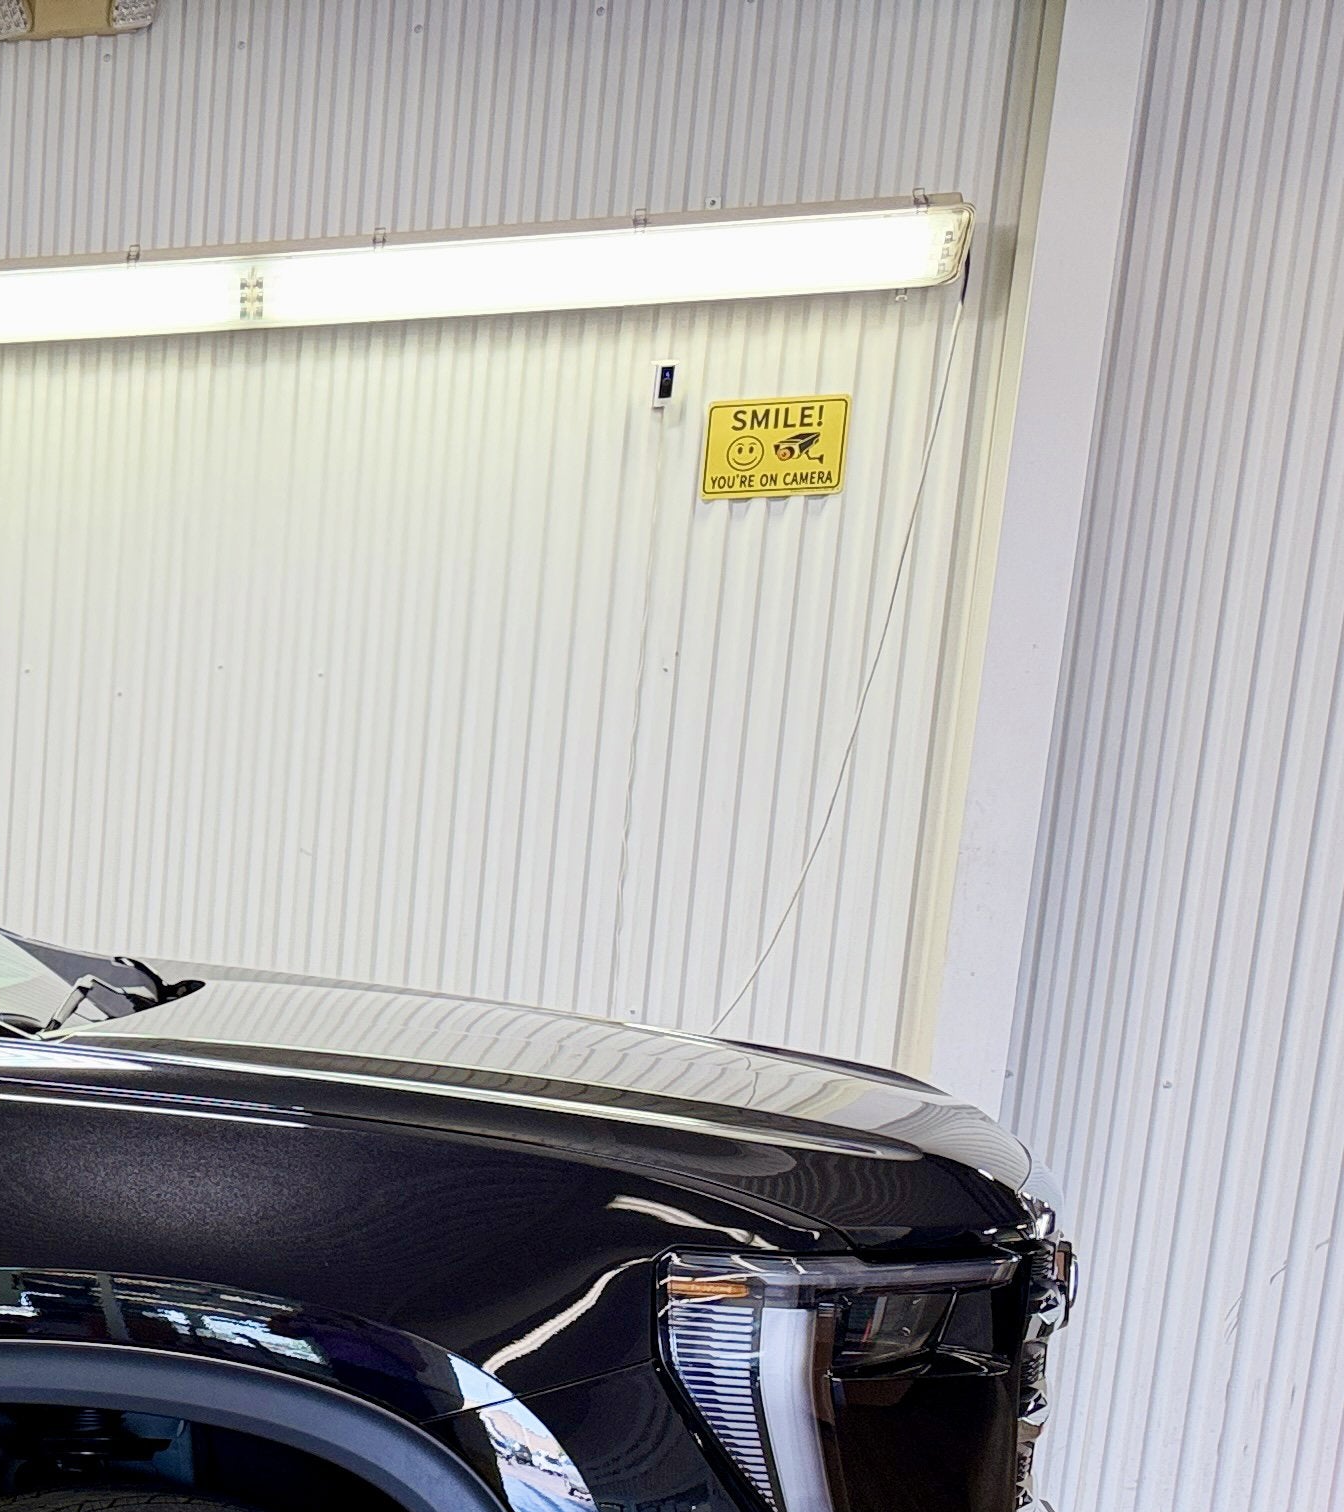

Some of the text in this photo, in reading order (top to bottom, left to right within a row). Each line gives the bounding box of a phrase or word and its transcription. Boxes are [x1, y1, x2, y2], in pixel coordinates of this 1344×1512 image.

[731, 404, 825, 432] SMILE!
[710, 470, 833, 490] YOU'RE ON CAMERA
